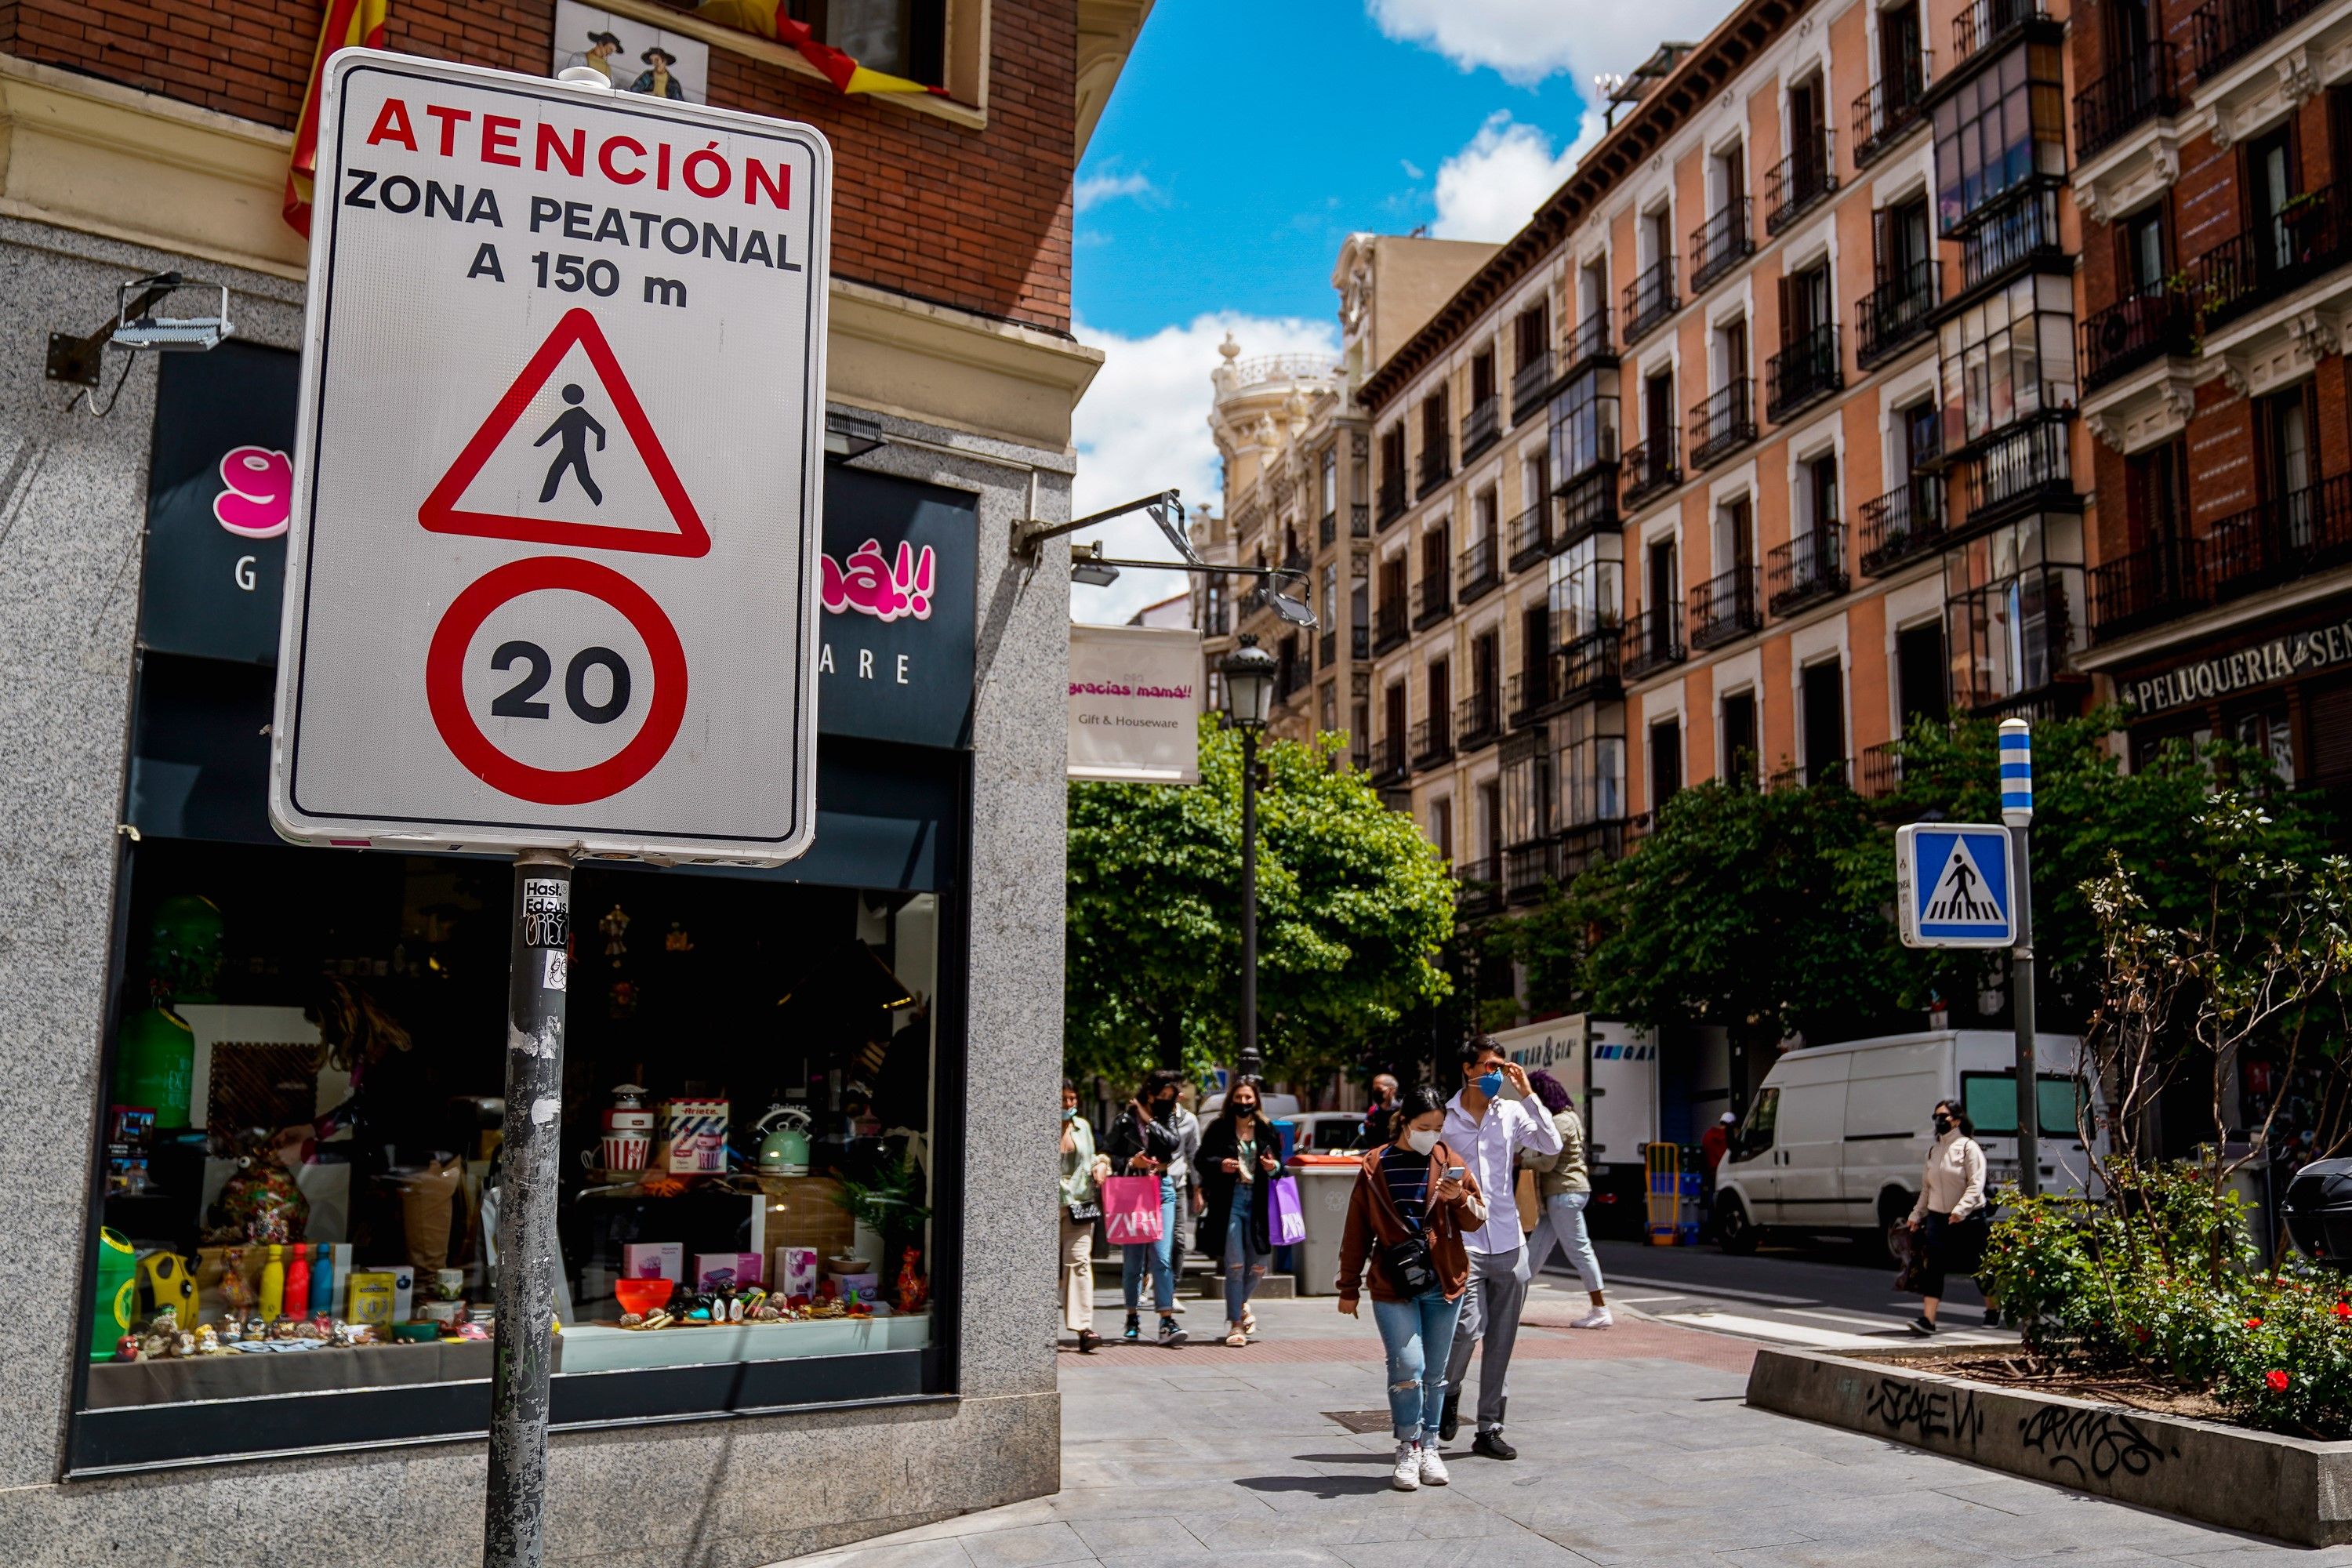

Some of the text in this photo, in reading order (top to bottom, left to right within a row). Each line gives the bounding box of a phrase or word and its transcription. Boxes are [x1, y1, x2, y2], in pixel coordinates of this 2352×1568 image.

[366, 97, 792, 211] ATENCIÓN
[344, 167, 802, 273] ZONA PEATONAL
[466, 242, 688, 308] A 150 m
[490, 640, 632, 724] 20
[1069, 681, 1192, 700] gracias mamá!!
[2137, 641, 2295, 714] PELUQUERIA
[1078, 713, 1179, 729] Gift & Houseware
